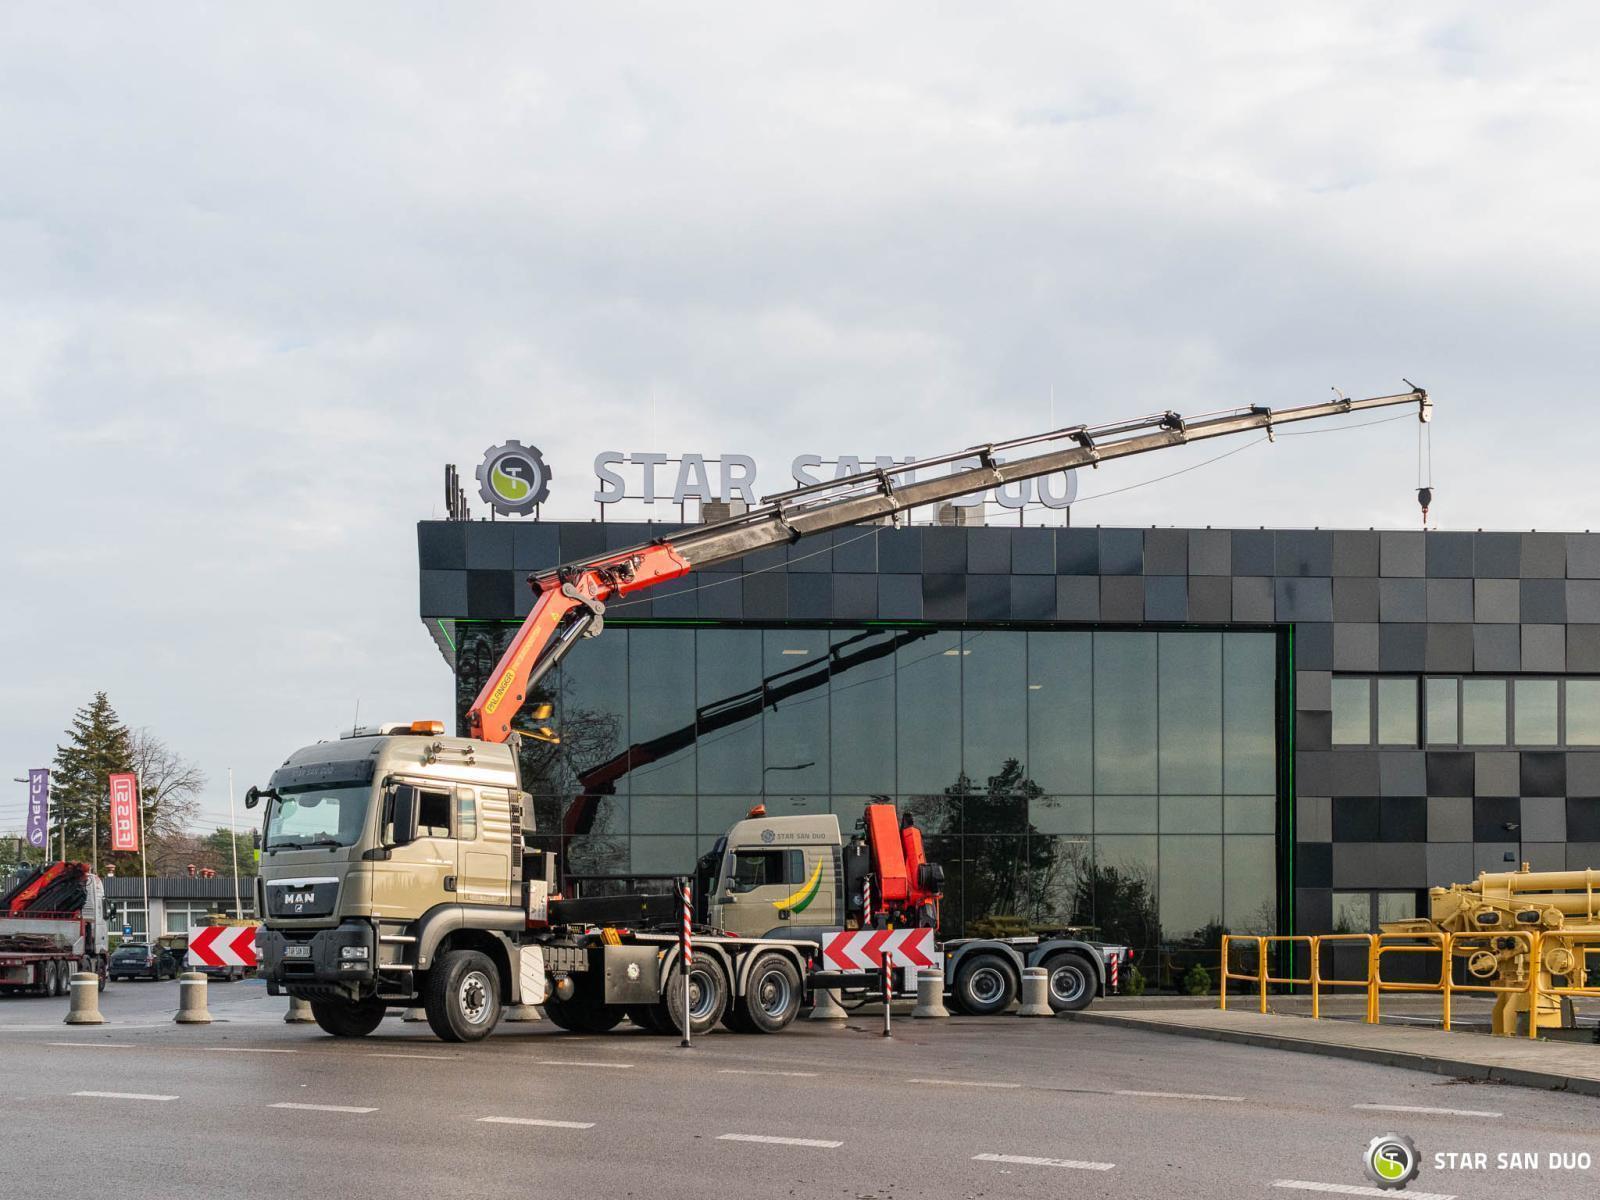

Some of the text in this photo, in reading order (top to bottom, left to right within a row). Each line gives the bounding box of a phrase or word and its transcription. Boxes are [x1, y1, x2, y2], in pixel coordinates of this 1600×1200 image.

[594, 451, 757, 505] STAR
[486, 672, 514, 713] PALFINGER
[284, 892, 315, 904] MAN
